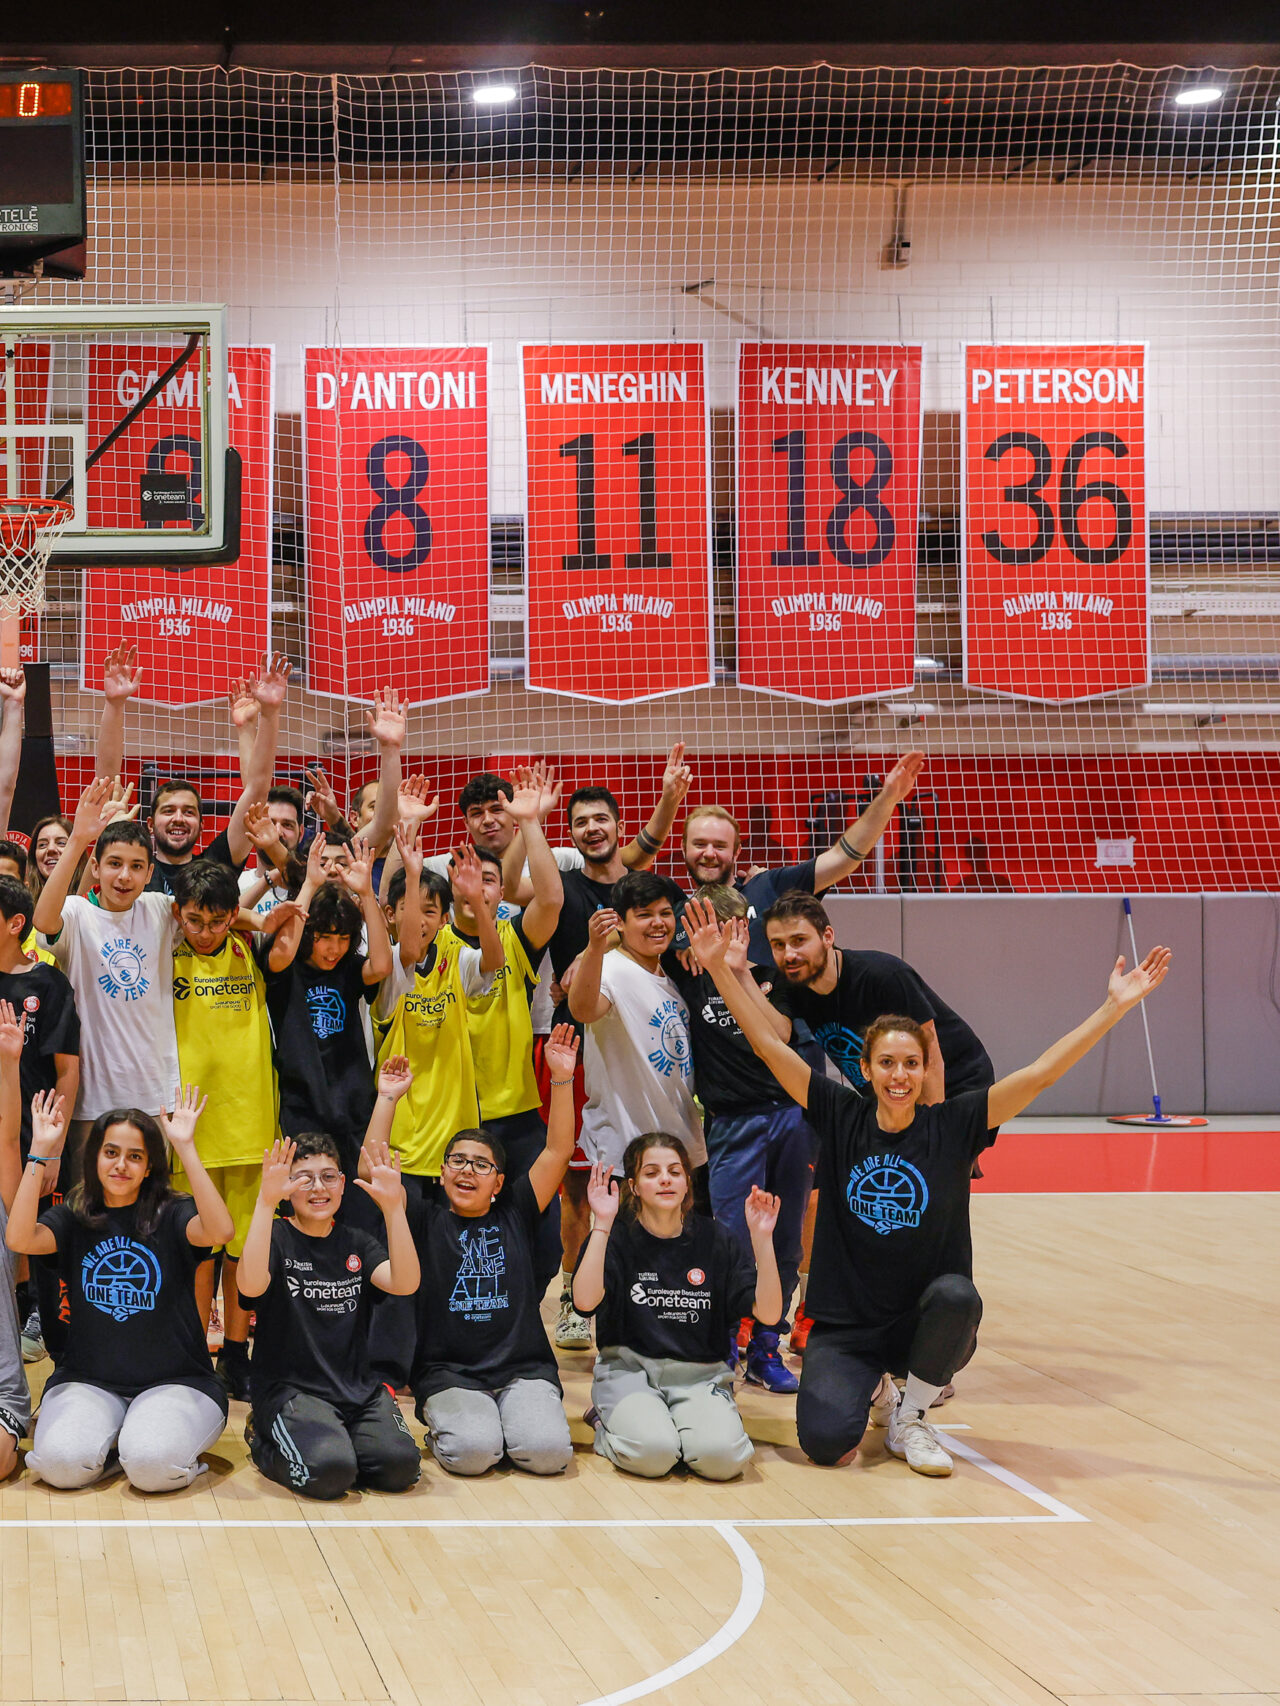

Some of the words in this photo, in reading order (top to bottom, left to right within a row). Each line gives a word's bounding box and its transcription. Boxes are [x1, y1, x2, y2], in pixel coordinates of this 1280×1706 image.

[19, 83, 40, 117] 0
[315, 371, 477, 410] D'ANTONI
[540, 371, 687, 404] MENEGHIN
[761, 366, 898, 407] KENNEY
[972, 368, 1139, 404] PETERSON
[364, 435, 433, 573] 8
[559, 432, 672, 570] 11
[770, 430, 895, 569] 18
[981, 431, 1132, 566] 36
[121, 597, 177, 622] OLIMPIA
[181, 597, 233, 624] MILANO
[344, 597, 400, 623] OLIMPIA
[404, 597, 456, 623] MILANO
[562, 593, 618, 620] OLIMPIA
[622, 593, 674, 620] MILANO
[771, 592, 827, 618] OLIMPIA
[831, 592, 884, 619] MILANO
[1002, 591, 1058, 618] OLIMPIA
[1062, 591, 1114, 617] MILANO
[158, 618, 191, 636] 1936
[381, 617, 414, 637] 1936
[600, 614, 633, 633] 1936
[809, 613, 841, 632] 1936
[1040, 611, 1073, 631] 1936
[98, 974, 121, 999] ONE
[124, 977, 150, 1002] TEAM
[648, 1008, 665, 1029] WE
[662, 1000, 679, 1014] ARE
[648, 1049, 676, 1077] ONE
[849, 1165, 865, 1183] WE
[863, 1155, 881, 1173] ARE
[883, 1153, 901, 1168] ALL
[851, 1198, 877, 1219] ONE
[880, 1206, 917, 1226] TEAM
[81, 1252, 100, 1269] WE
[95, 1238, 116, 1258] ARE
[459, 1226, 505, 1259] WE
[456, 1253, 506, 1278] ARE
[86, 1285, 113, 1303] ONE
[115, 1289, 152, 1308] TEAM
[449, 1276, 508, 1301] ALL
[647, 1288, 681, 1297] Euroleague
[449, 1300, 473, 1312] ONE
[474, 1297, 509, 1311] TEAM
[647, 1295, 712, 1310] oneteam
